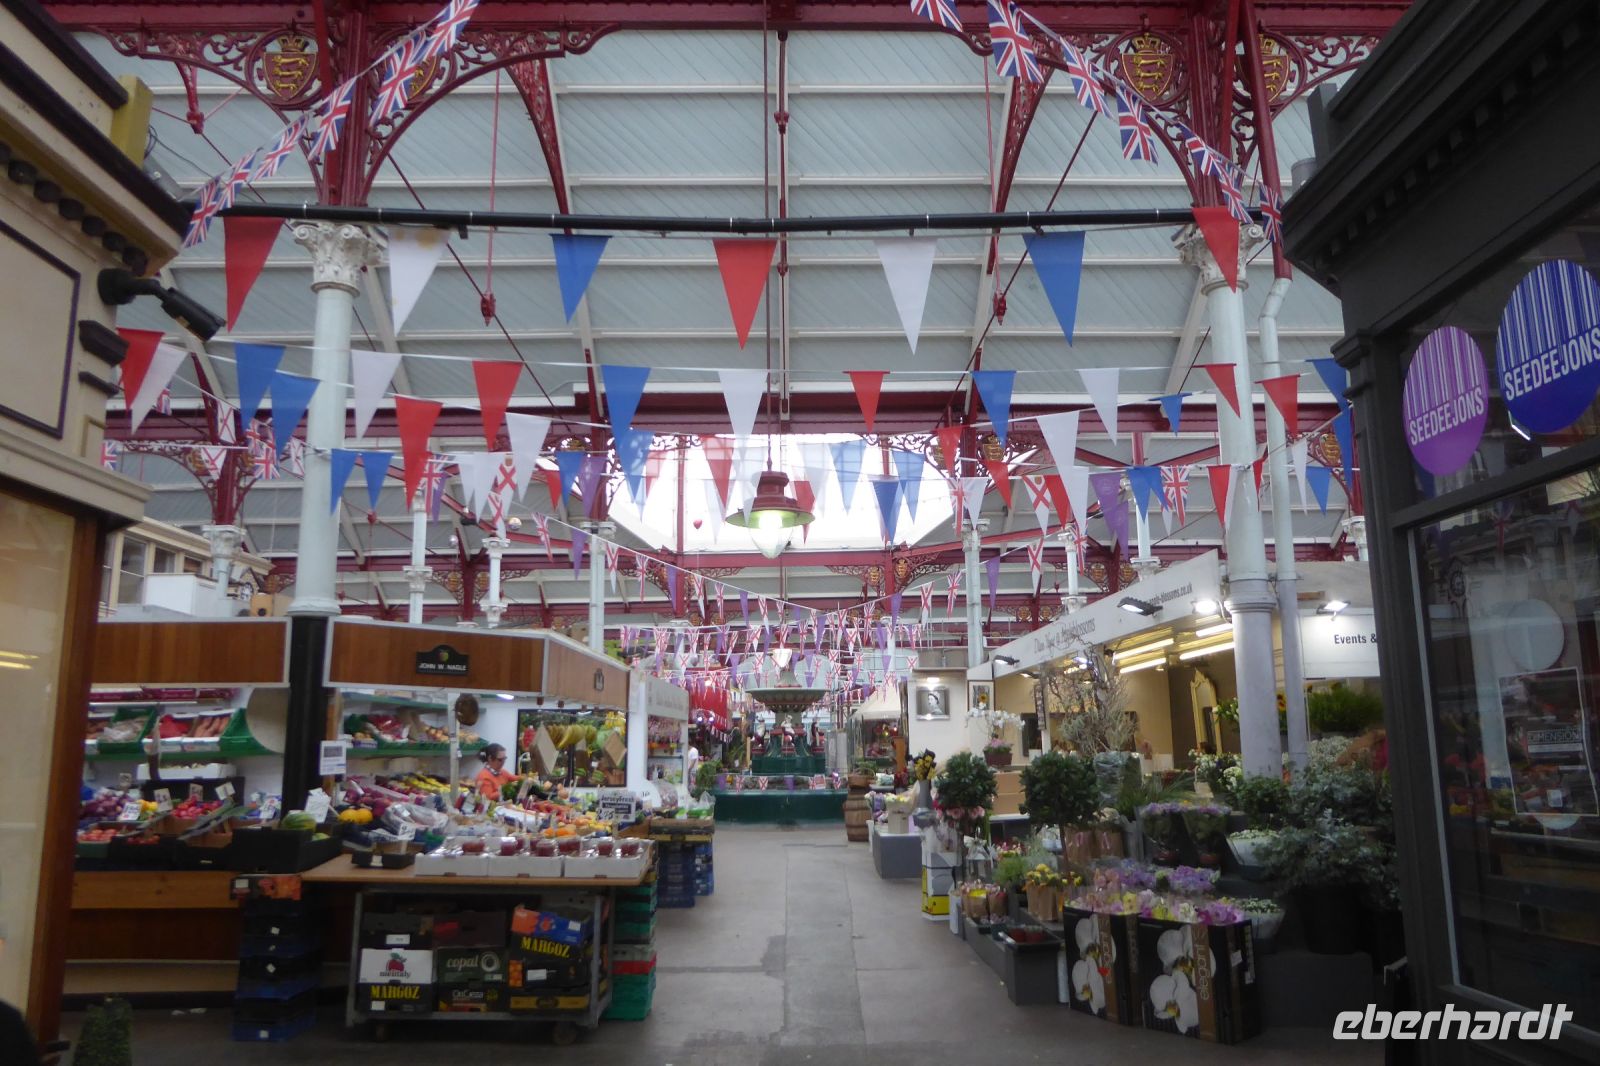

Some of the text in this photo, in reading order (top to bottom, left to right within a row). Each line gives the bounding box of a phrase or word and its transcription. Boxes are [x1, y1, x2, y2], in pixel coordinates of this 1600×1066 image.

[1504, 327, 1600, 402] SEEDEEJONS
[1409, 387, 1485, 446] SEEDEEJONS
[1334, 633, 1377, 644] Events &
[520, 936, 570, 958] MARGOZ
[446, 955, 479, 971] copal
[1195, 943, 1210, 1000] elegant
[370, 985, 421, 1000] MARGOZ
